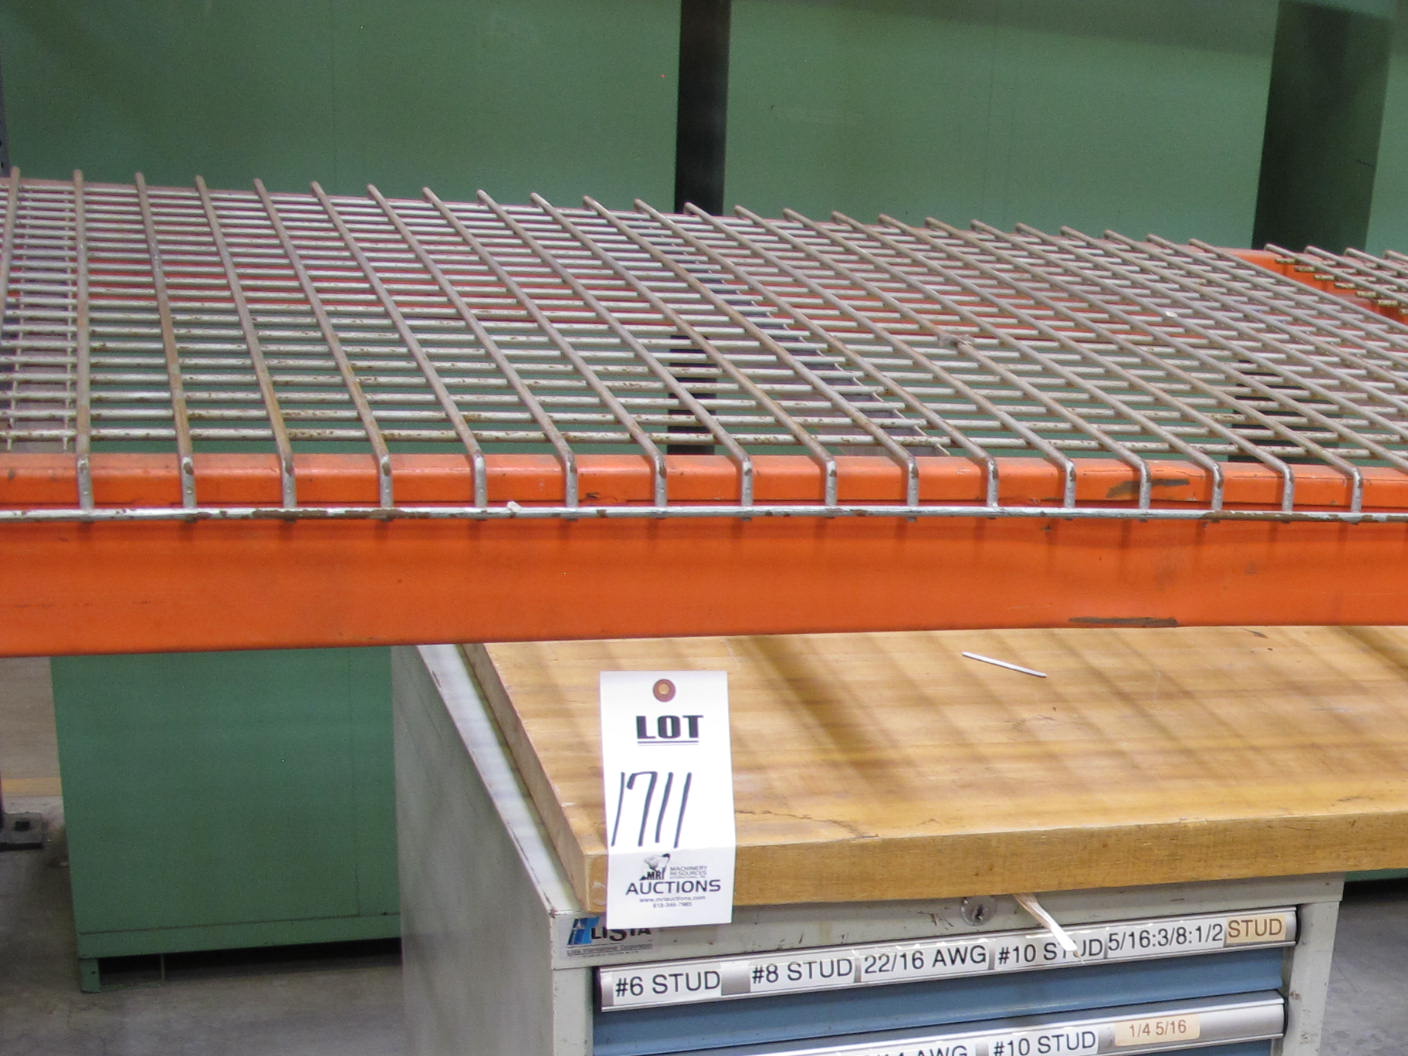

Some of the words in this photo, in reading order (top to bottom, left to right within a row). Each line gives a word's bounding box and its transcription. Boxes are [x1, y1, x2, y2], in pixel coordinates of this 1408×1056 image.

[636, 715, 704, 739] LOT
[611, 771, 692, 848] 1711
[625, 879, 721, 895] AUCTIONS
[1108, 923, 1224, 951] 5/16:3/8:1/2
[1228, 917, 1283, 939] STUD
[863, 951, 925, 975] 22/16
[932, 945, 987, 968] AWG
[998, 943, 1037, 965] #10
[752, 965, 779, 984] #8
[787, 957, 853, 980] STUD
[615, 976, 644, 997] #6
[652, 970, 721, 994] STUD
[1129, 1023, 1150, 1038] 1/4
[1155, 1020, 1187, 1036] 5/16
[1038, 1031, 1096, 1054] STUD
